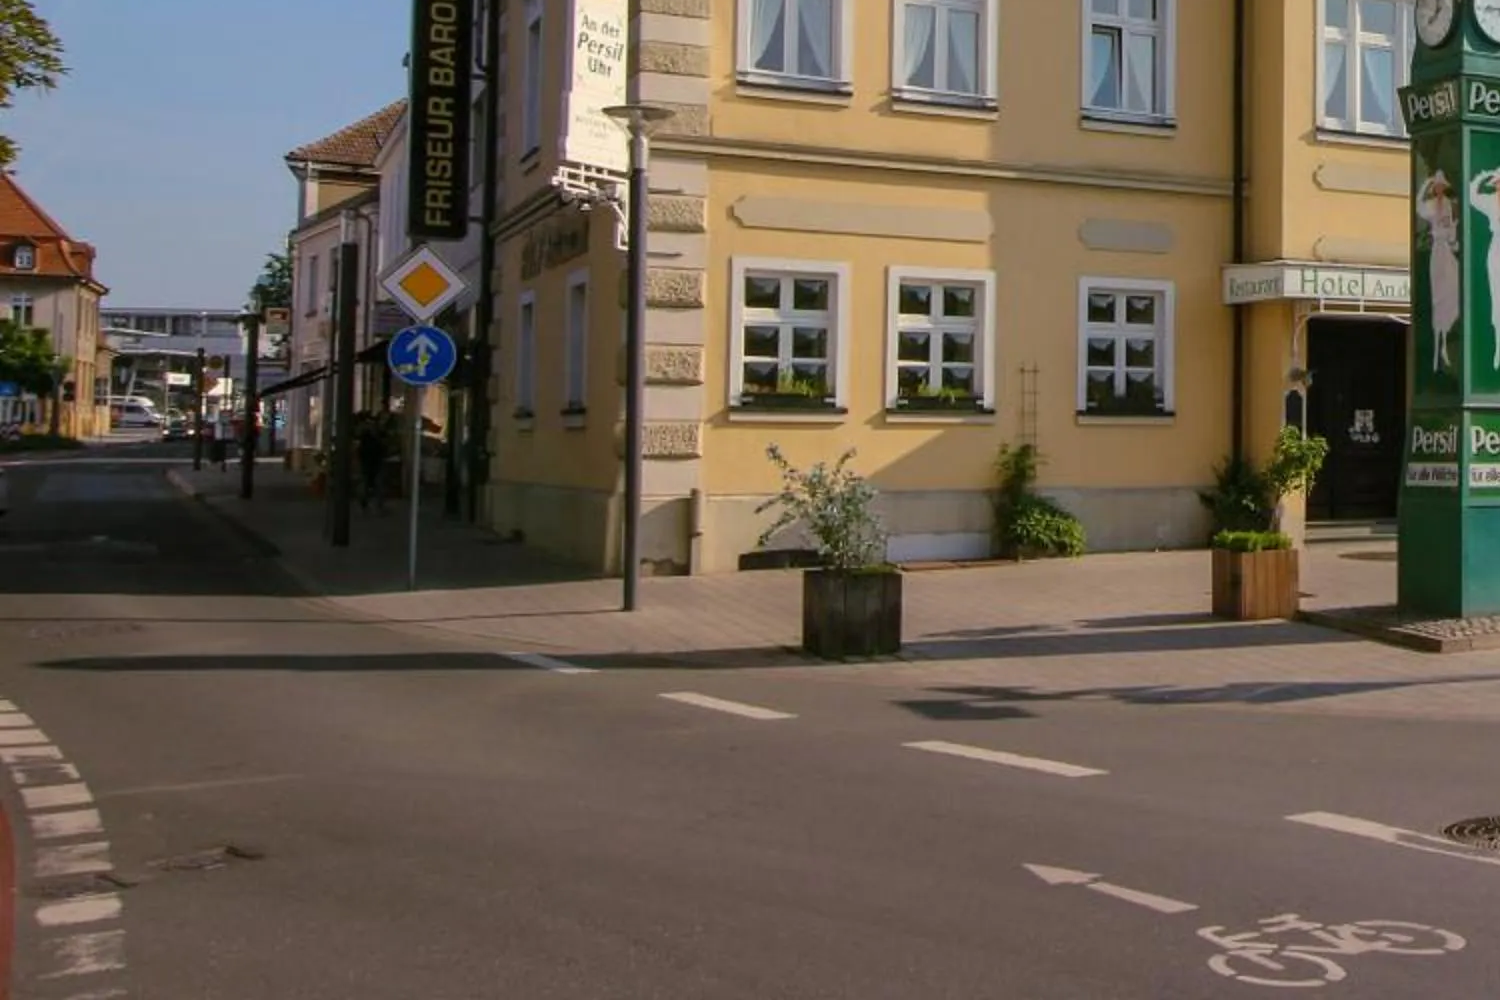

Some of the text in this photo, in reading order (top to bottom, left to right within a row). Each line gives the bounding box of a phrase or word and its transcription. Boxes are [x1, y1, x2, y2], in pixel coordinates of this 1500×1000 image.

[581, 13, 620, 39] An der
[577, 31, 625, 62] Persil
[587, 56, 613, 78] Uhr
[1407, 81, 1456, 122] Persil
[425, 97, 455, 228] FRISEUR
[1300, 267, 1365, 297] Hotel
[1373, 279, 1395, 297] An
[1411, 424, 1458, 455] Persil
